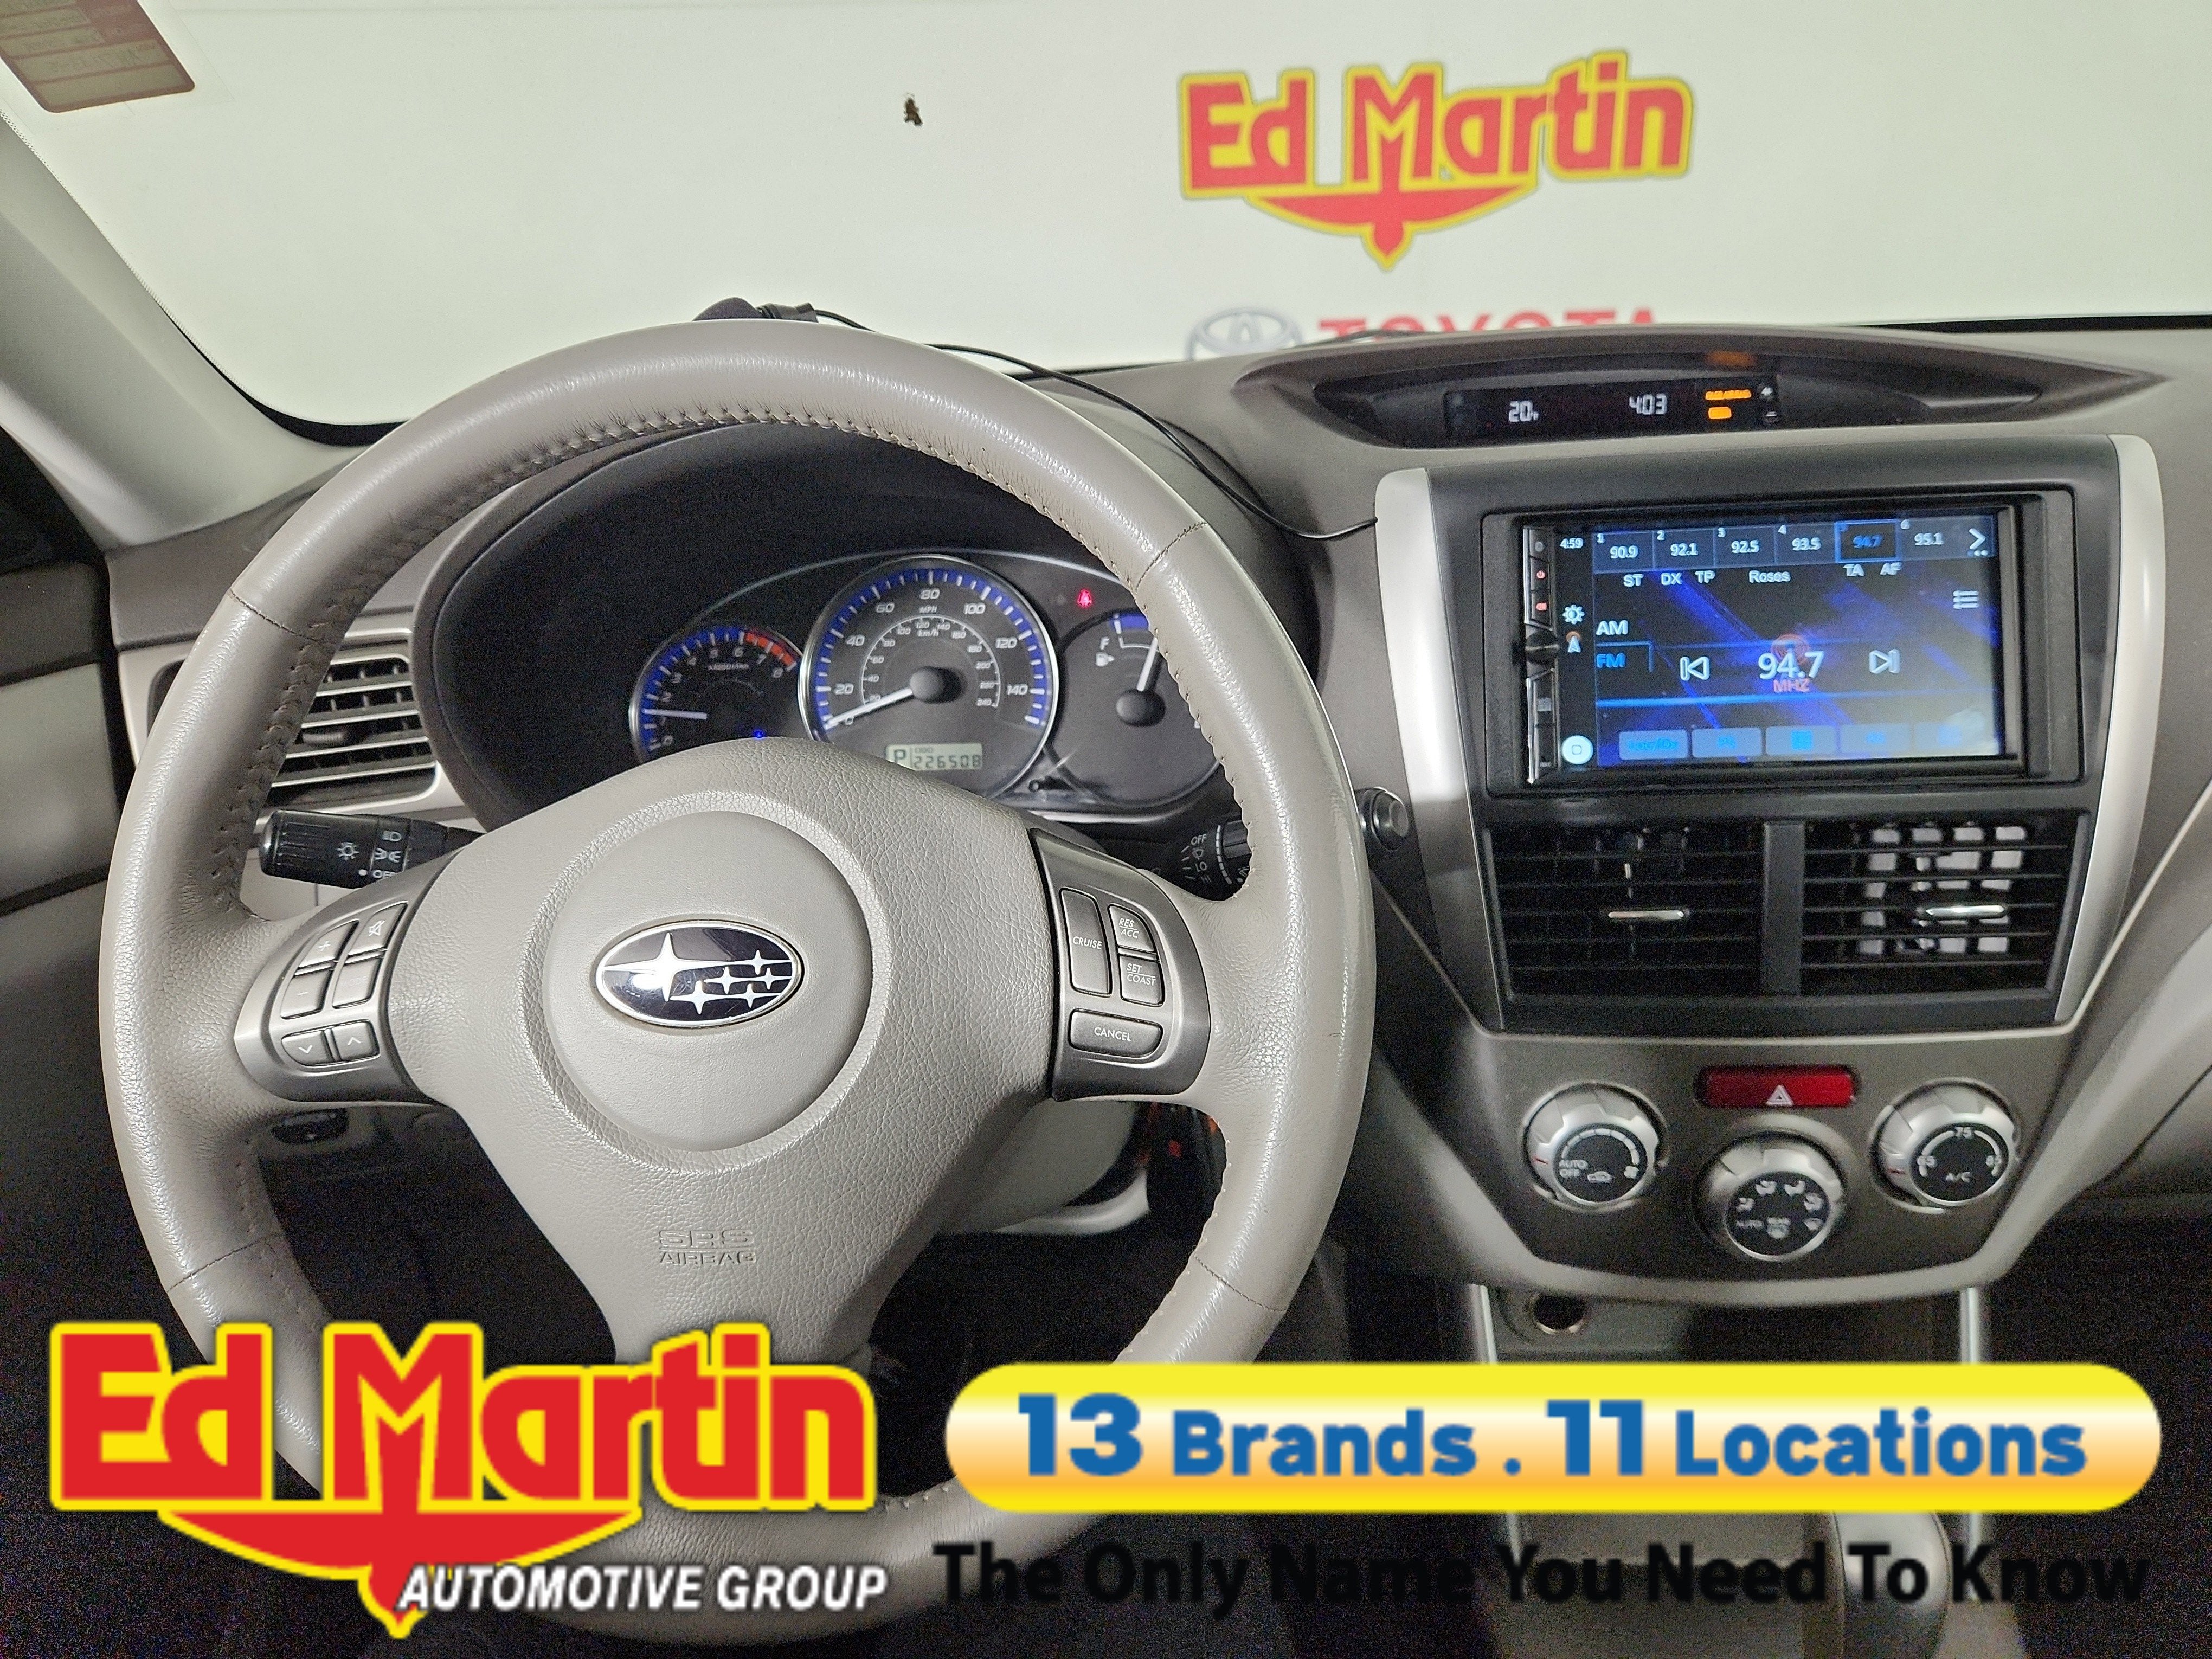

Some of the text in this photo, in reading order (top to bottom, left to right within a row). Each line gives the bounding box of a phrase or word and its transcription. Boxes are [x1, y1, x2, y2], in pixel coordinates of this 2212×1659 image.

[1181, 50, 1693, 198] Ed Martin
[1778, 525, 1786, 535] 4
[1900, 519, 1910, 530] 6
[1597, 533, 1604, 543] 1
[1657, 530, 1665, 540] 2
[1718, 528, 1725, 537] 3
[1792, 537, 1821, 551] 93.5
[1914, 532, 1944, 546] 95.1
[1610, 546, 1638, 558] 90.9
[1670, 543, 1699, 556] 92.1
[1731, 540, 1759, 553] 92.5
[1843, 564, 1865, 577] TA
[1880, 562, 1902, 575] AF
[1623, 574, 1643, 587] ST
[1661, 573, 1682, 586] DX
[1695, 570, 1716, 584] TP
[920, 588, 940, 600] 80
[876, 602, 895, 614] 60
[919, 606, 938, 614] MPH
[963, 602, 986, 615] 100
[897, 627, 911, 635] 100
[917, 629, 938, 638] km/h
[1596, 620, 1628, 637] AM
[846, 635, 865, 647] 40
[995, 637, 1018, 649] 120
[1099, 636, 1110, 650] F
[687, 656, 697, 666] 4
[756, 654, 767, 664] 7
[1597, 653, 1626, 668] FM
[1758, 651, 1824, 680] 94.7
[834, 684, 854, 695] 20
[1006, 684, 1028, 696] 140
[662, 691, 671, 702] 2
[663, 735, 673, 746] 0
[894, 749, 906, 763] P
[914, 755, 982, 768] 226508
[1191, 834, 1207, 845] OFF
[1195, 861, 1207, 871] LO
[1118, 918, 1135, 928] RES
[1120, 928, 1139, 939] ACC
[1072, 936, 1103, 950] CRUISE
[1127, 963, 1142, 973] SET
[1127, 974, 1156, 986] COAST
[1094, 1027, 1131, 1042] CANCEL
[1559, 1160, 1588, 1169] AUTO
[659, 1230, 755, 1247] SRS
[659, 1251, 756, 1265] AIRBAG
